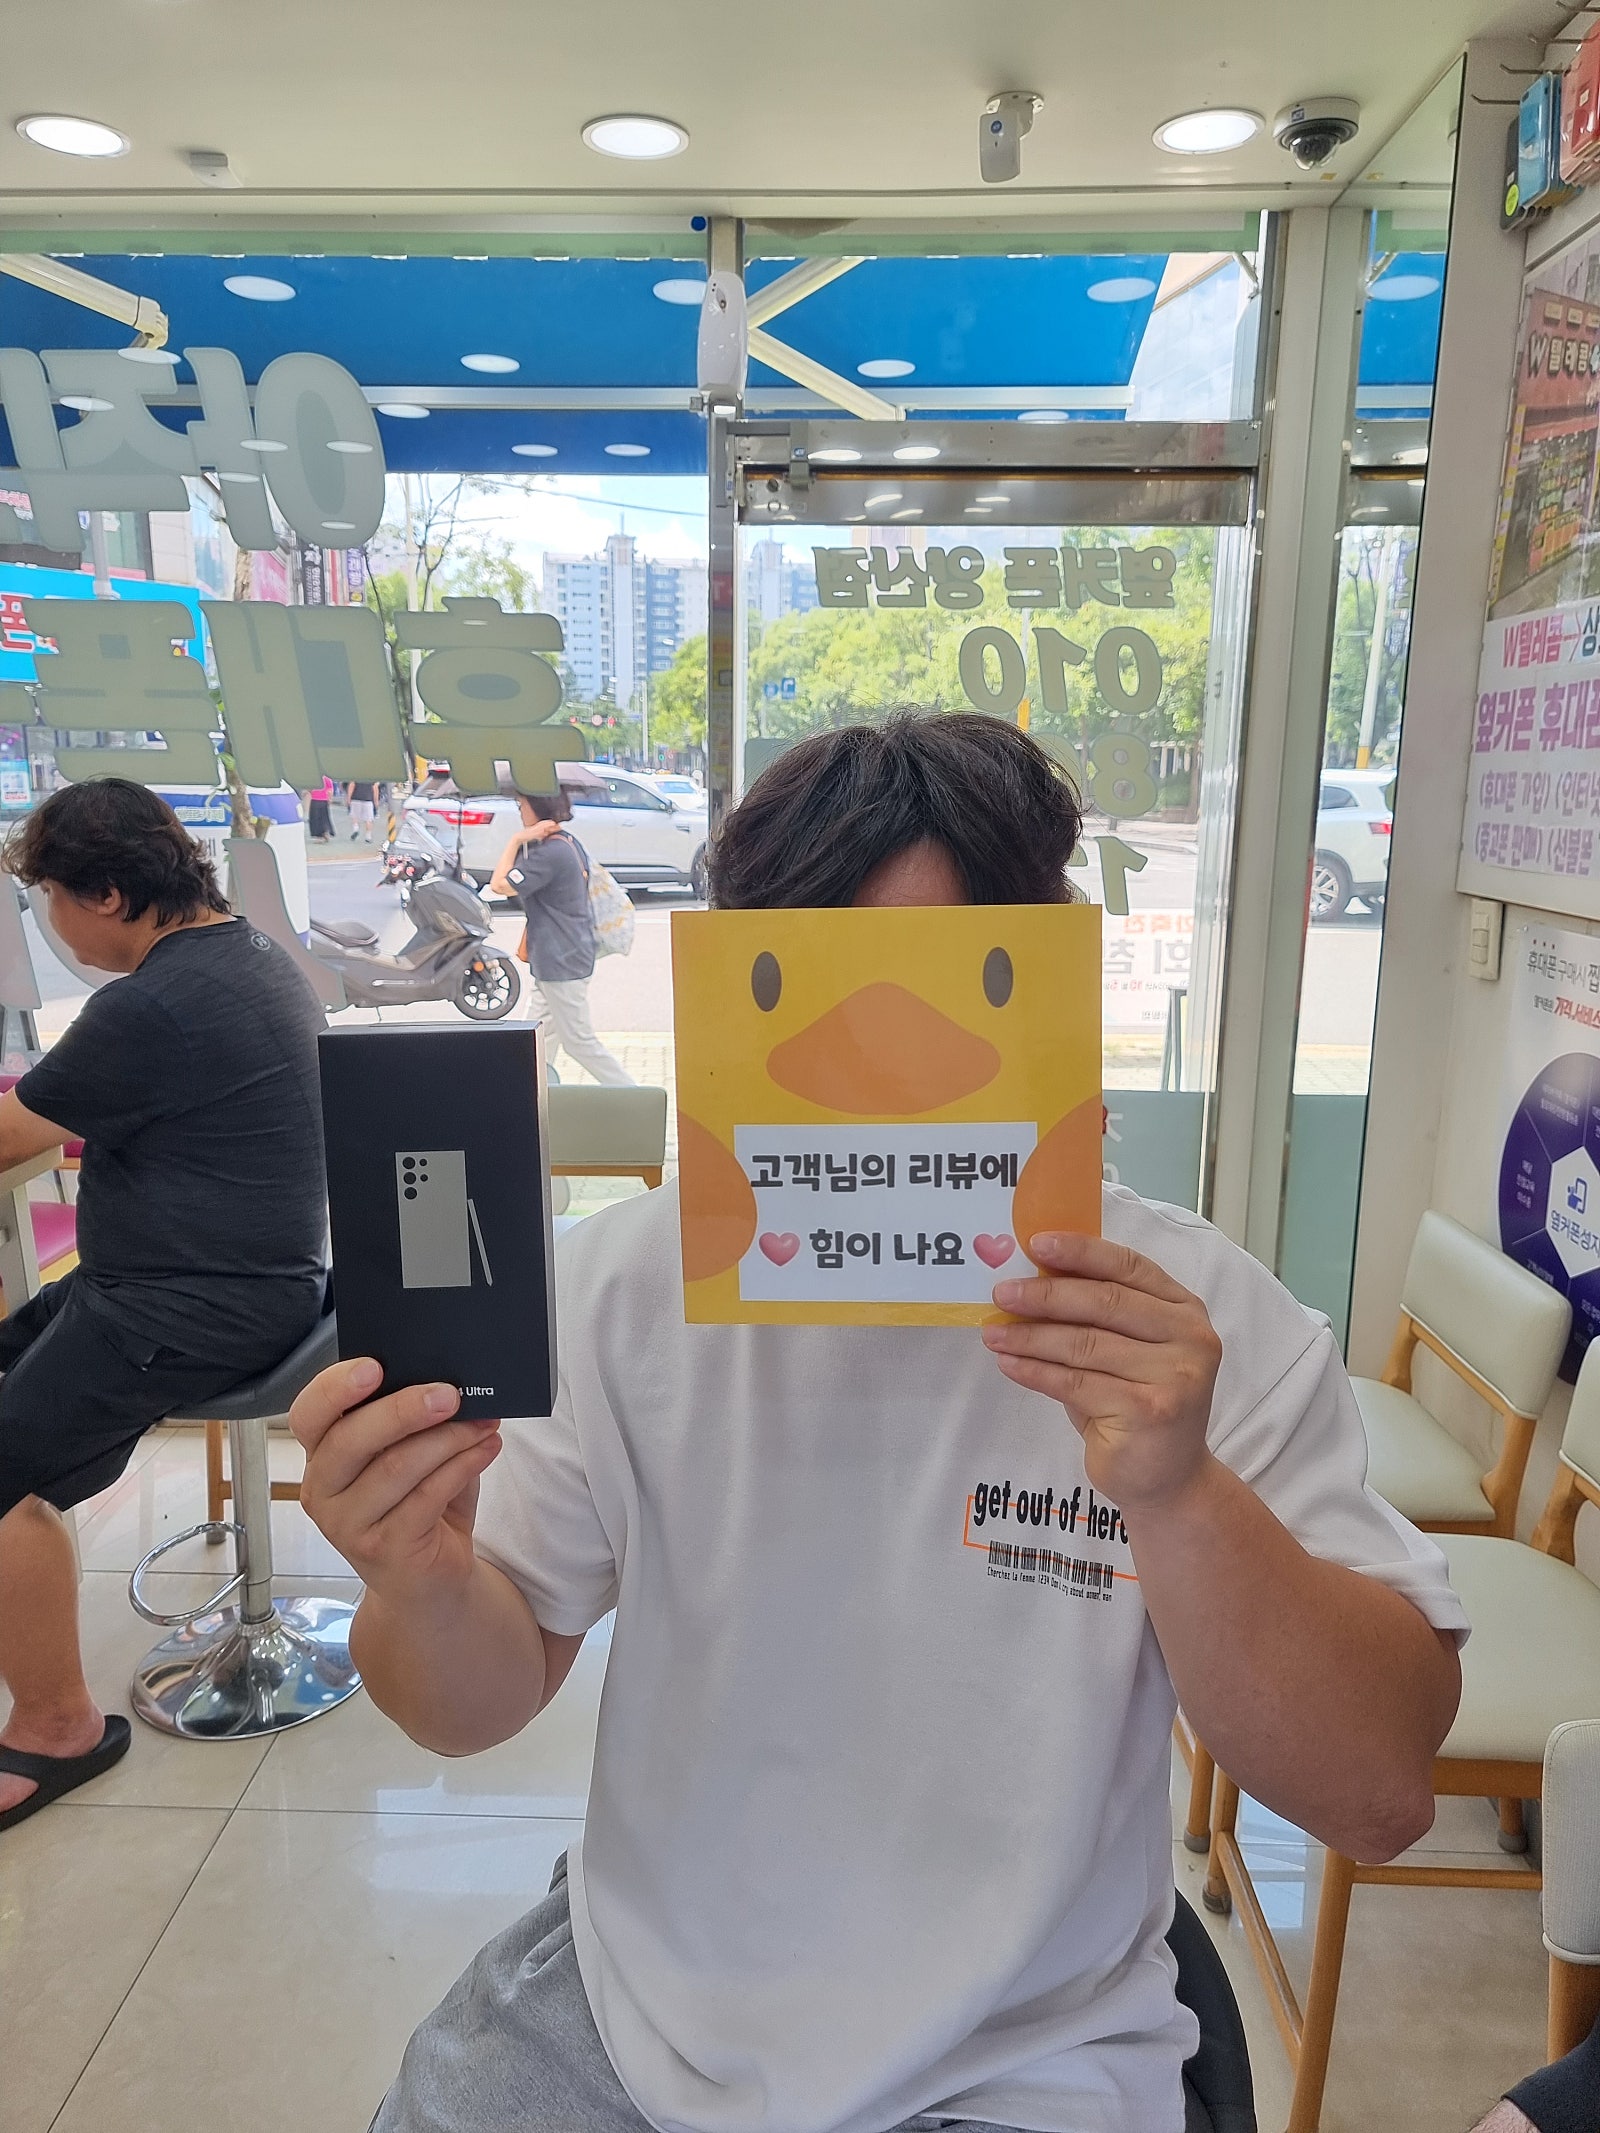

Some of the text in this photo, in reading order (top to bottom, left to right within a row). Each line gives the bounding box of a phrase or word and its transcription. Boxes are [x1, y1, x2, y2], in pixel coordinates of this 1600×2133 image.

[1475, 686, 1536, 753] 옆커폰
[750, 1152, 1018, 1193] 고객님의 리뷰에
[808, 1228, 965, 1269] 힘이 나요
[466, 1386, 494, 1396] Ultra
[974, 1480, 1011, 1527] get
[1016, 1487, 1054, 1526] out
[1058, 1486, 1082, 1533] of
